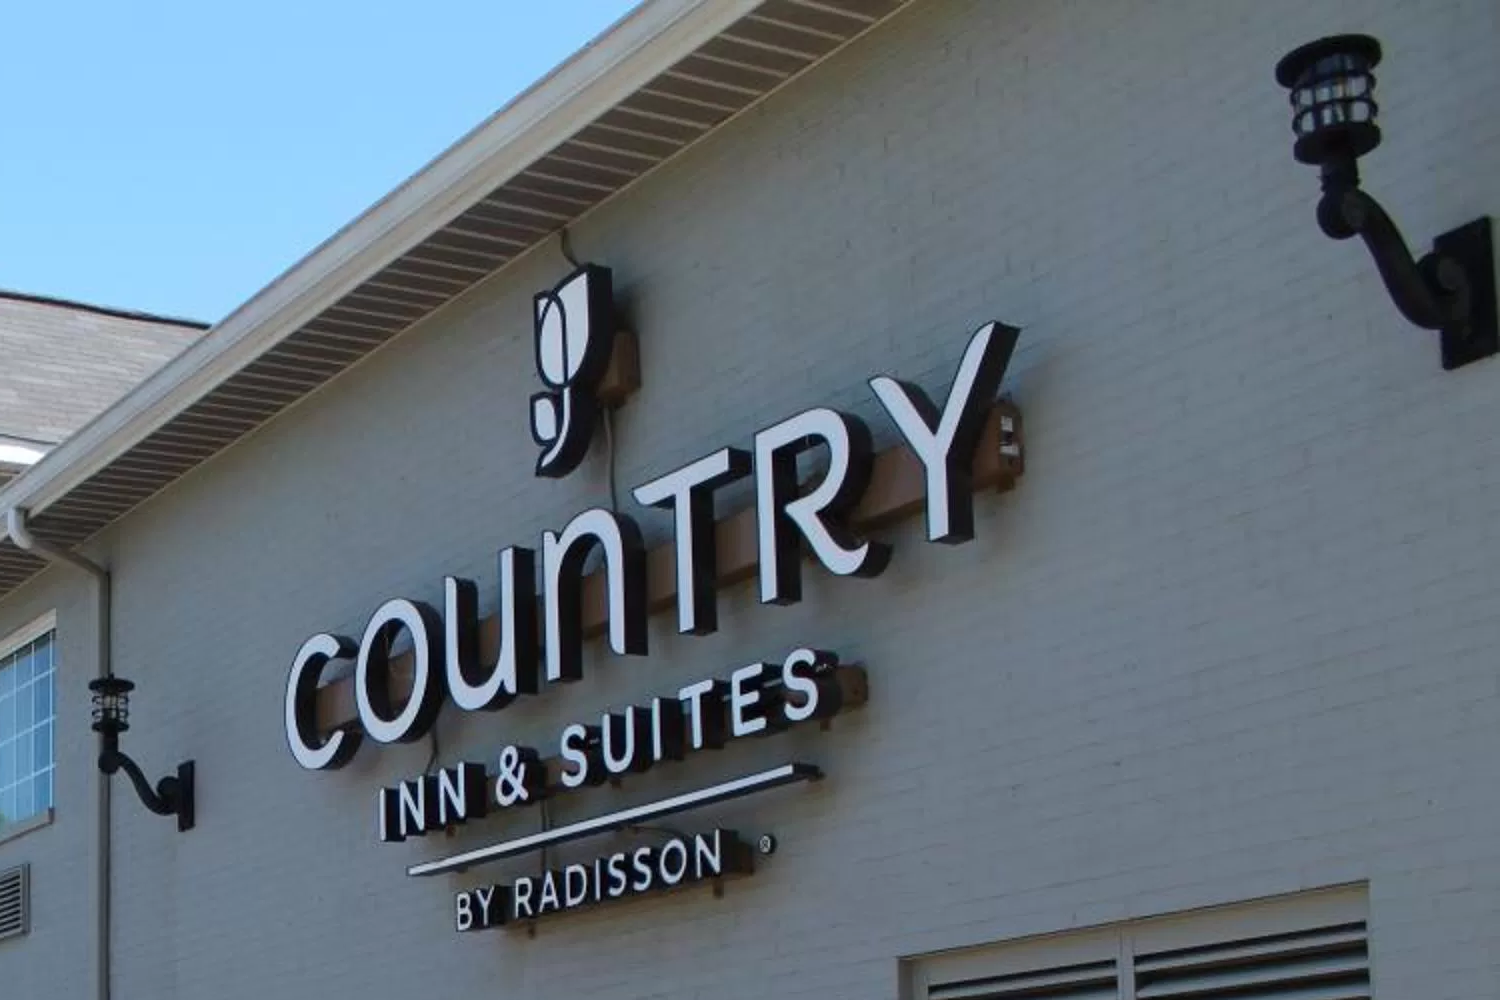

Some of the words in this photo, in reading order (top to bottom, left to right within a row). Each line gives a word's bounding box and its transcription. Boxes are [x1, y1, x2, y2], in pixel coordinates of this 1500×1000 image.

[377, 761, 468, 843] INN
[494, 744, 531, 807] &
[560, 647, 821, 789] SUITES
[456, 885, 496, 932] BY
[513, 828, 722, 919] RADISSON
